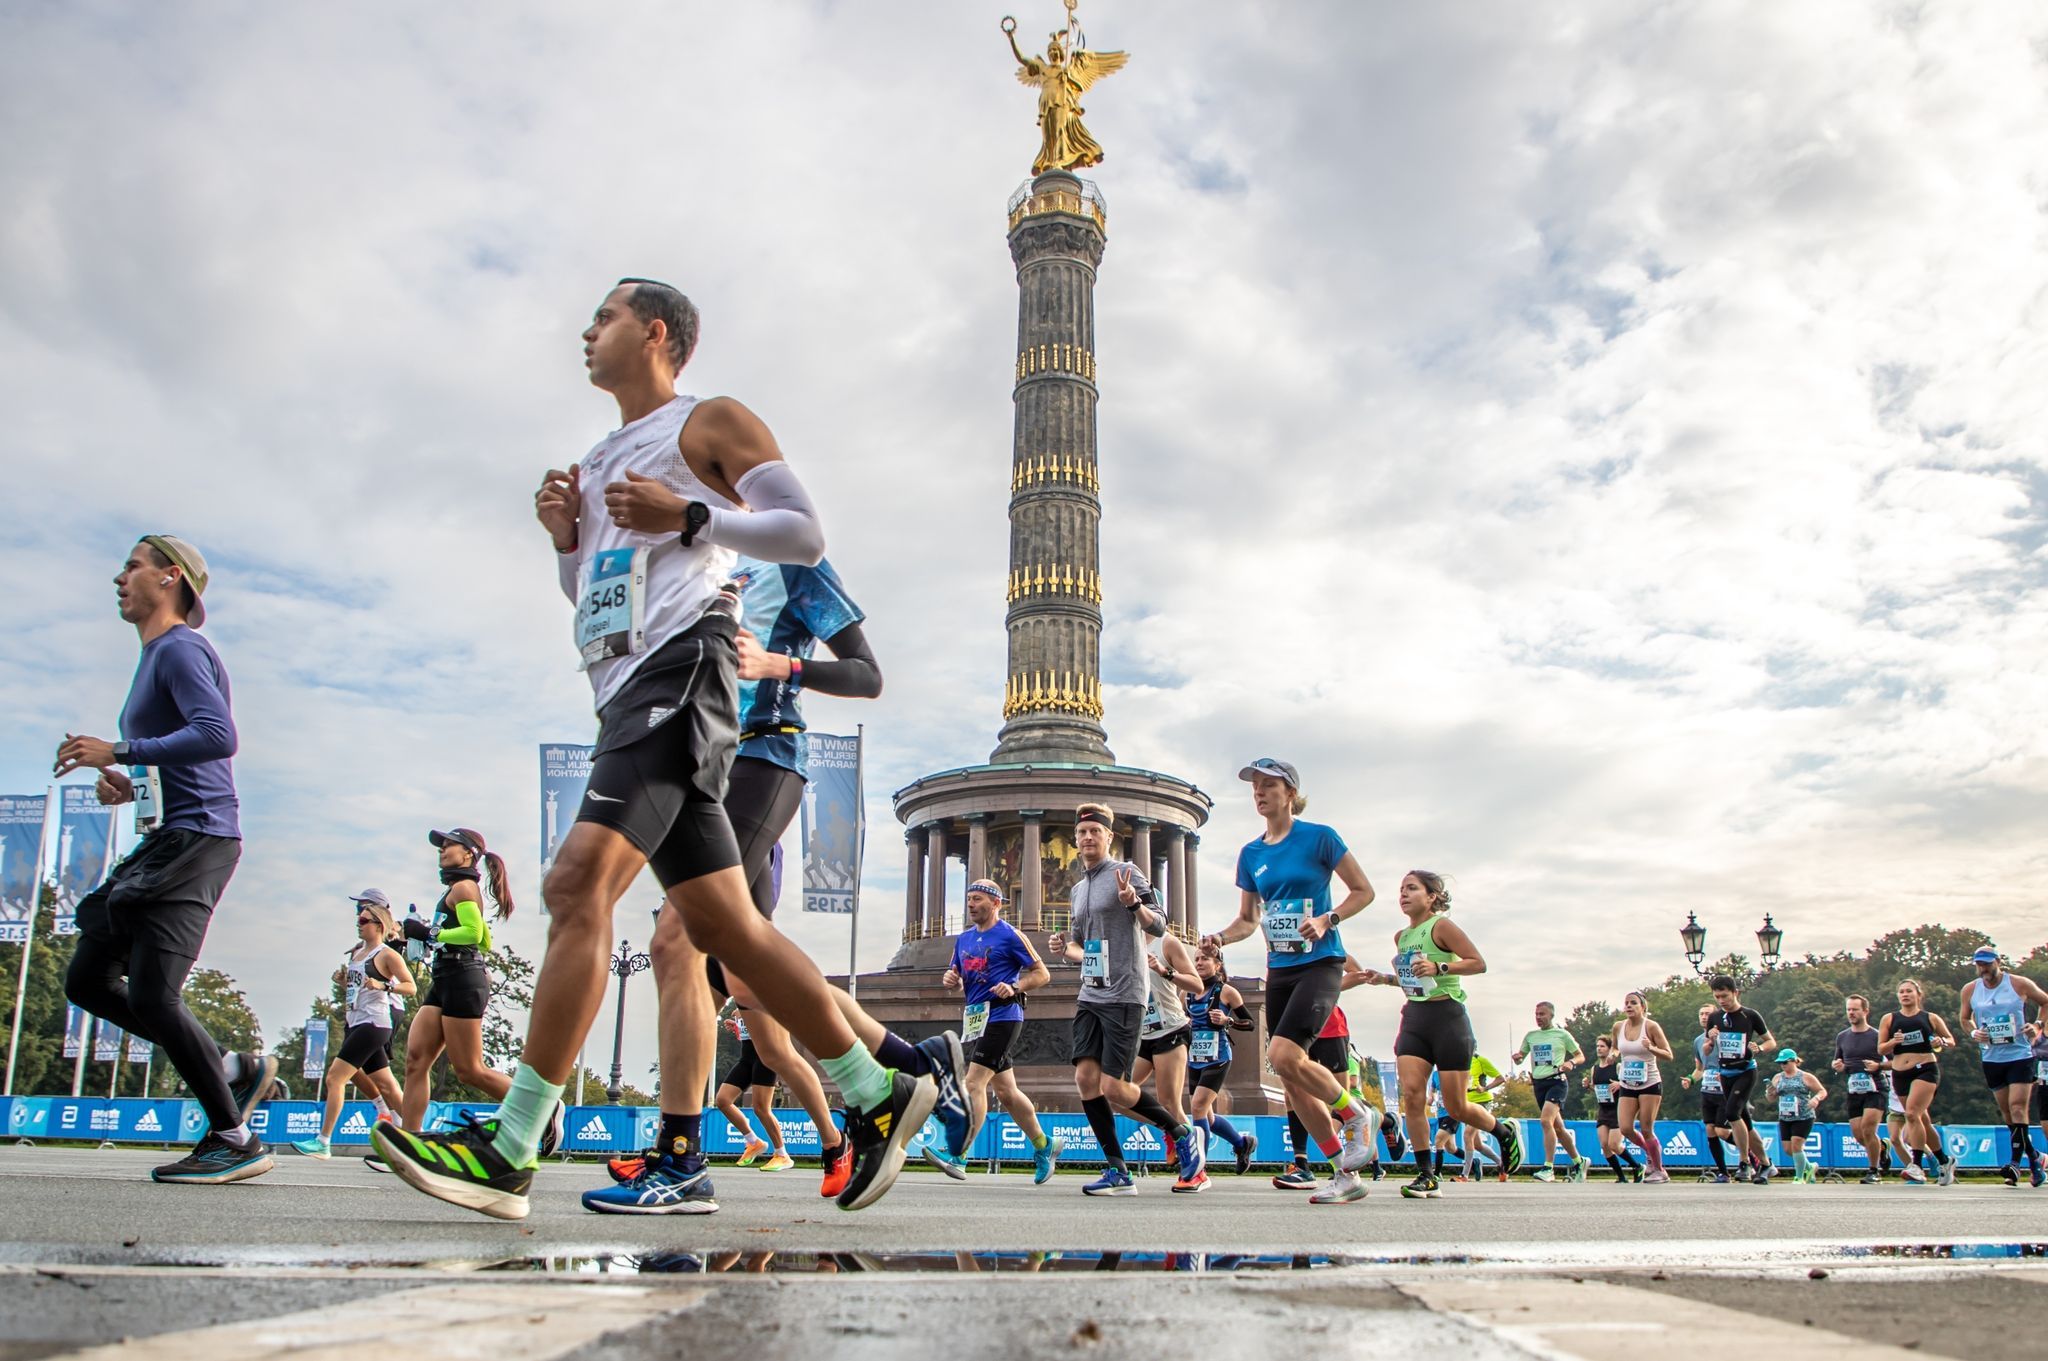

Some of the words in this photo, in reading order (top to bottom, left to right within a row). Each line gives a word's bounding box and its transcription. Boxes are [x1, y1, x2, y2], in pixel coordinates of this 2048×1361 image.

[1268, 918, 1298, 930] 12521
[288, 1113, 309, 1121] BMW
[577, 1131, 612, 1140] adidas
[1053, 1127, 1081, 1136] BMW
[1123, 1142, 1160, 1151] adidas
[1664, 1147, 1697, 1156] adidas
